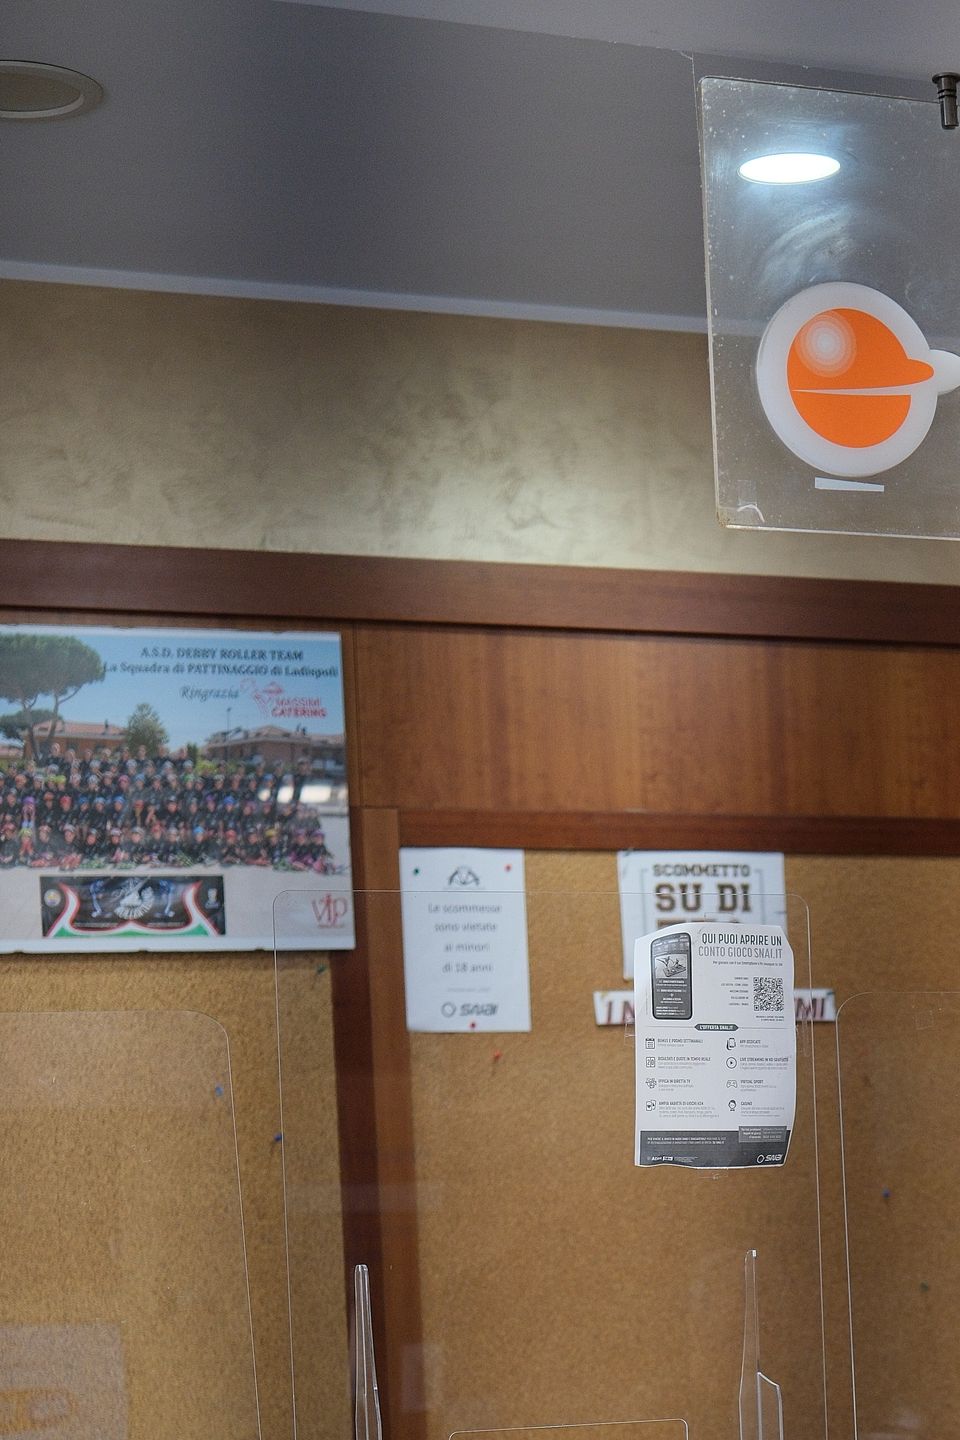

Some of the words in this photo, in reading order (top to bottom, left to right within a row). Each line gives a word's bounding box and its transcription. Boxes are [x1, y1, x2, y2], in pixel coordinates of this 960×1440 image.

[220, 648, 266, 661] ROLLER
[270, 649, 304, 661] TEAM
[120, 663, 169, 675] Squadra
[173, 663, 185, 674] di
[188, 664, 268, 676] PATTINAGGIO
[180, 685, 240, 702] Ringrazia
[653, 864, 750, 877] SCOMMETTO
[655, 882, 702, 913] SU
[717, 882, 753, 913] DI
[701, 933, 716, 944] QUI
[718, 933, 738, 945] PUOI
[740, 934, 768, 945] APRIRE
[770, 935, 782, 946] UN
[698, 945, 726, 957] CONTO
[727, 946, 752, 958] GIOCO
[455, 962, 468, 972] 18
